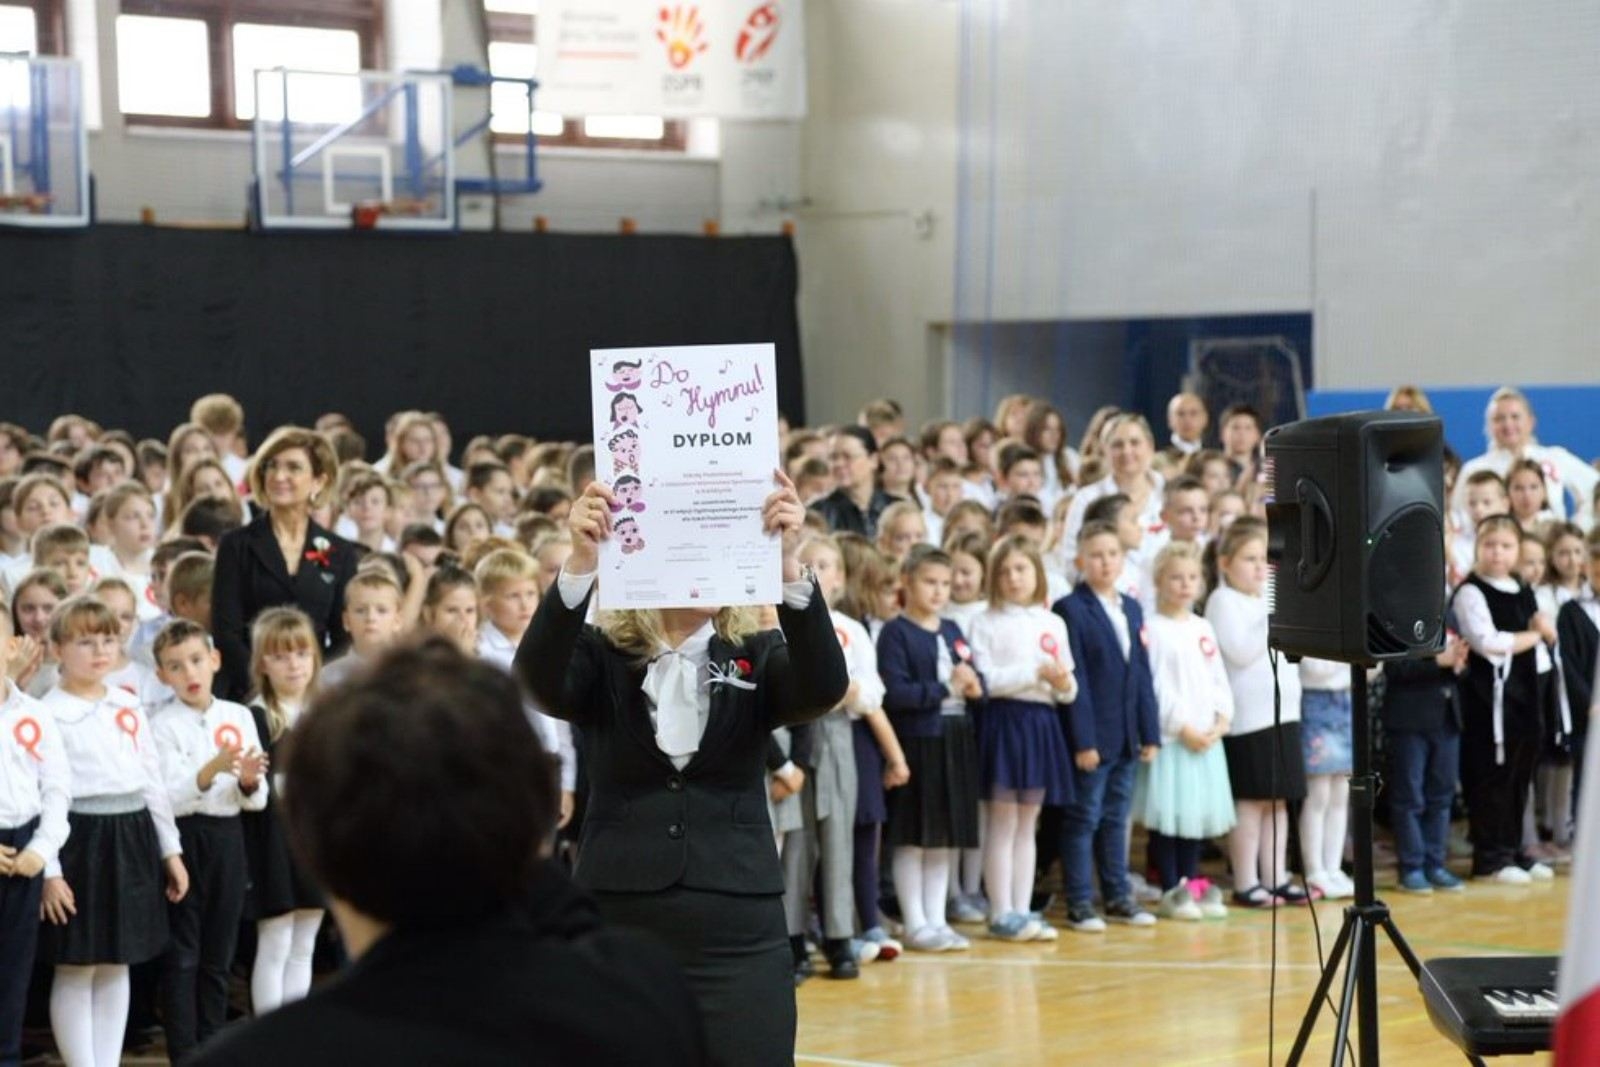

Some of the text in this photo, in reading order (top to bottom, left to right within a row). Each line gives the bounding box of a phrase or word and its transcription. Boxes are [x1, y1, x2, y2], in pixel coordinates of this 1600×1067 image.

[650, 361, 689, 388] Do
[680, 363, 764, 429] Hymnu!
[673, 432, 752, 448] DYPLOM
